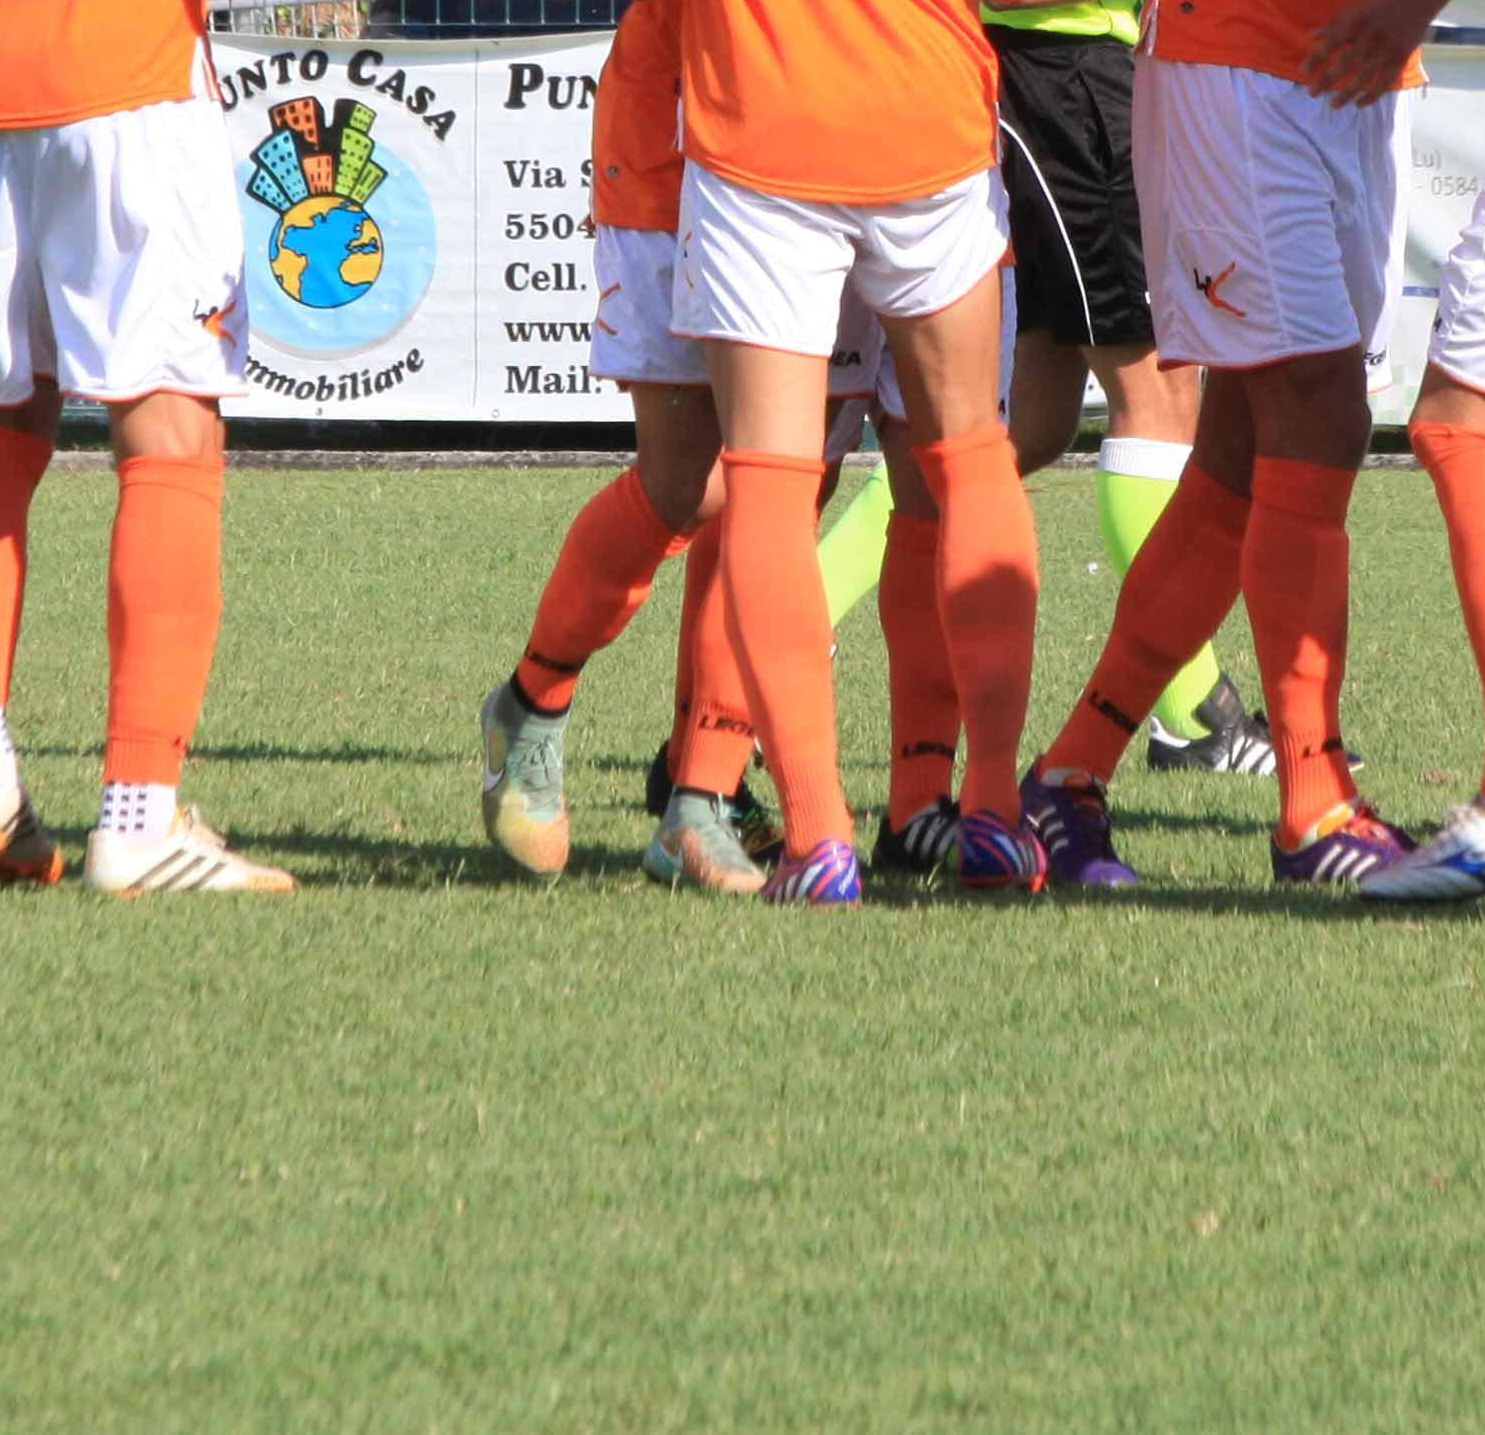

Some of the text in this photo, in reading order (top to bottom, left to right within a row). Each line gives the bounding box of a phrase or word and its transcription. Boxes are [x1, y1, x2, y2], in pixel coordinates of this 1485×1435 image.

[347, 48, 457, 142] CASA
[503, 160, 567, 189] Via
[504, 262, 587, 292] Cell.
[504, 365, 602, 395] Mail.
